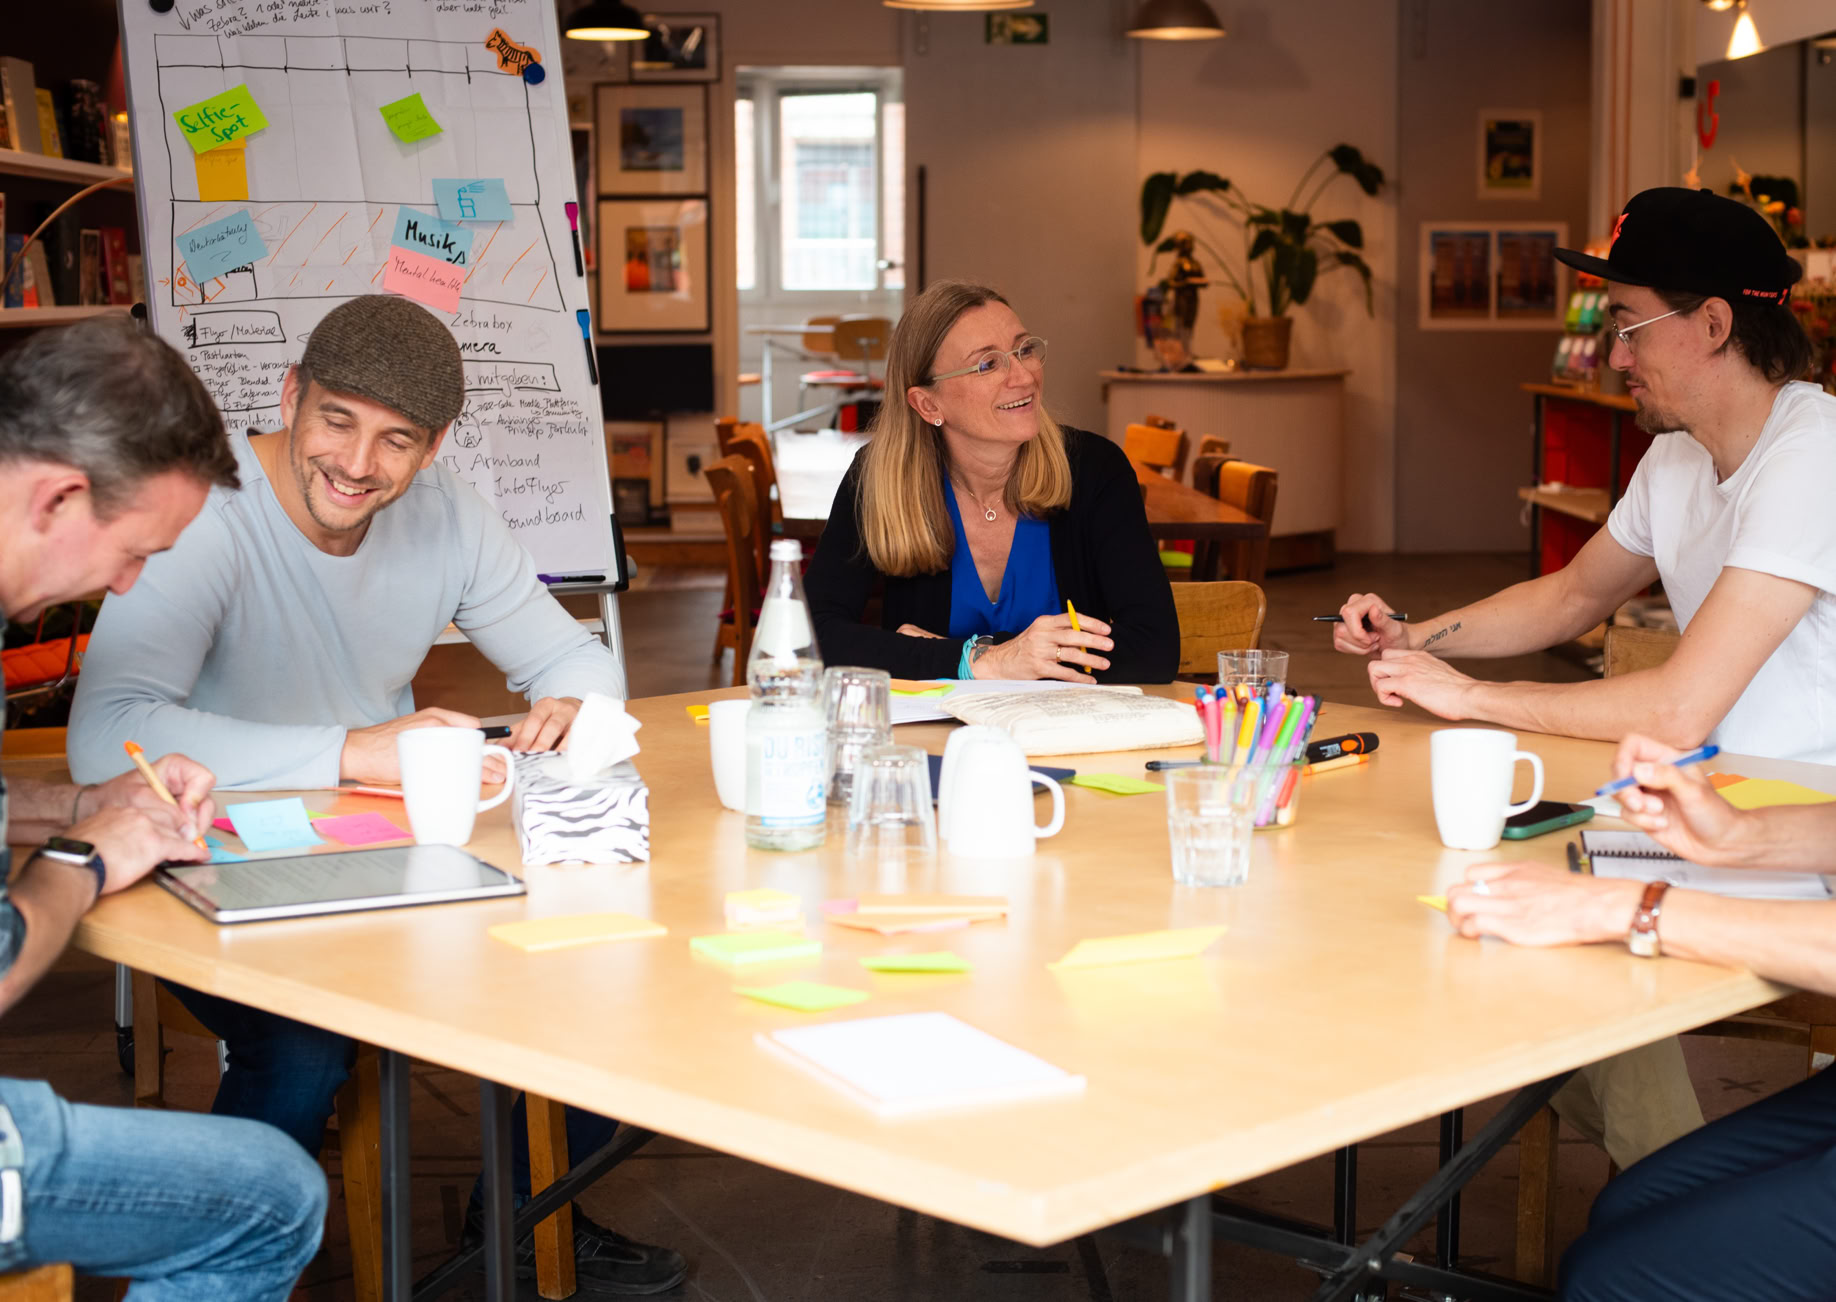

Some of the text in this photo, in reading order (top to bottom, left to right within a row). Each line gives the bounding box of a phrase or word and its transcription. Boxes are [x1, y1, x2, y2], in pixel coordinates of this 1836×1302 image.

[405, 219, 456, 254] Musik
[460, 341, 502, 355] mera
[470, 453, 540, 471] Armband
